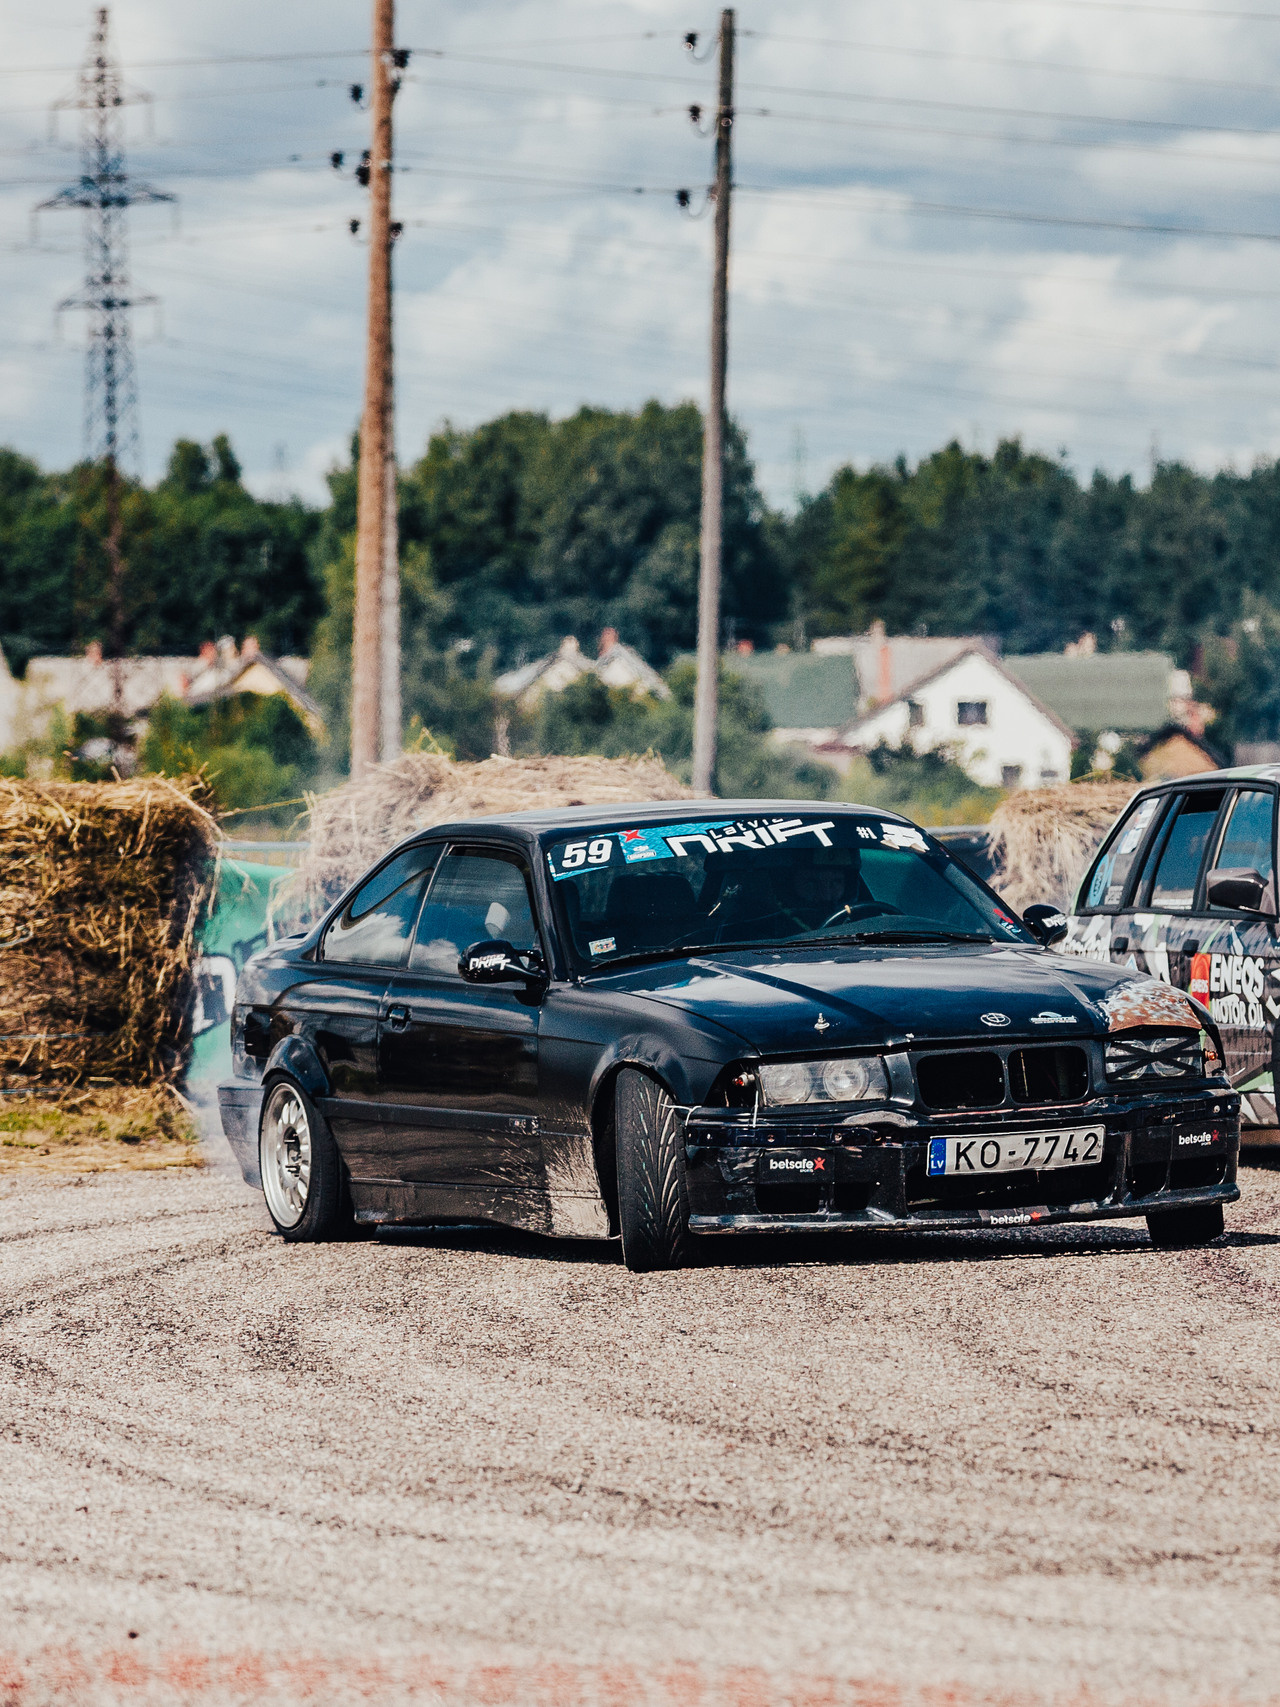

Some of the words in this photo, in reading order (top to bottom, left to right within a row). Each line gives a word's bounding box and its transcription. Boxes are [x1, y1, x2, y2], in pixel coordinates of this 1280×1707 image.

[666, 819, 836, 857] DRIFT
[561, 838, 613, 868] 59
[1211, 996, 1247, 1026] MOTOR
[1178, 1131, 1212, 1146] betsafe
[954, 1132, 1100, 1171] KO-7742
[769, 1158, 814, 1170] betsafe
[930, 1159, 944, 1170] LV
[990, 1213, 1032, 1225] betsafe
